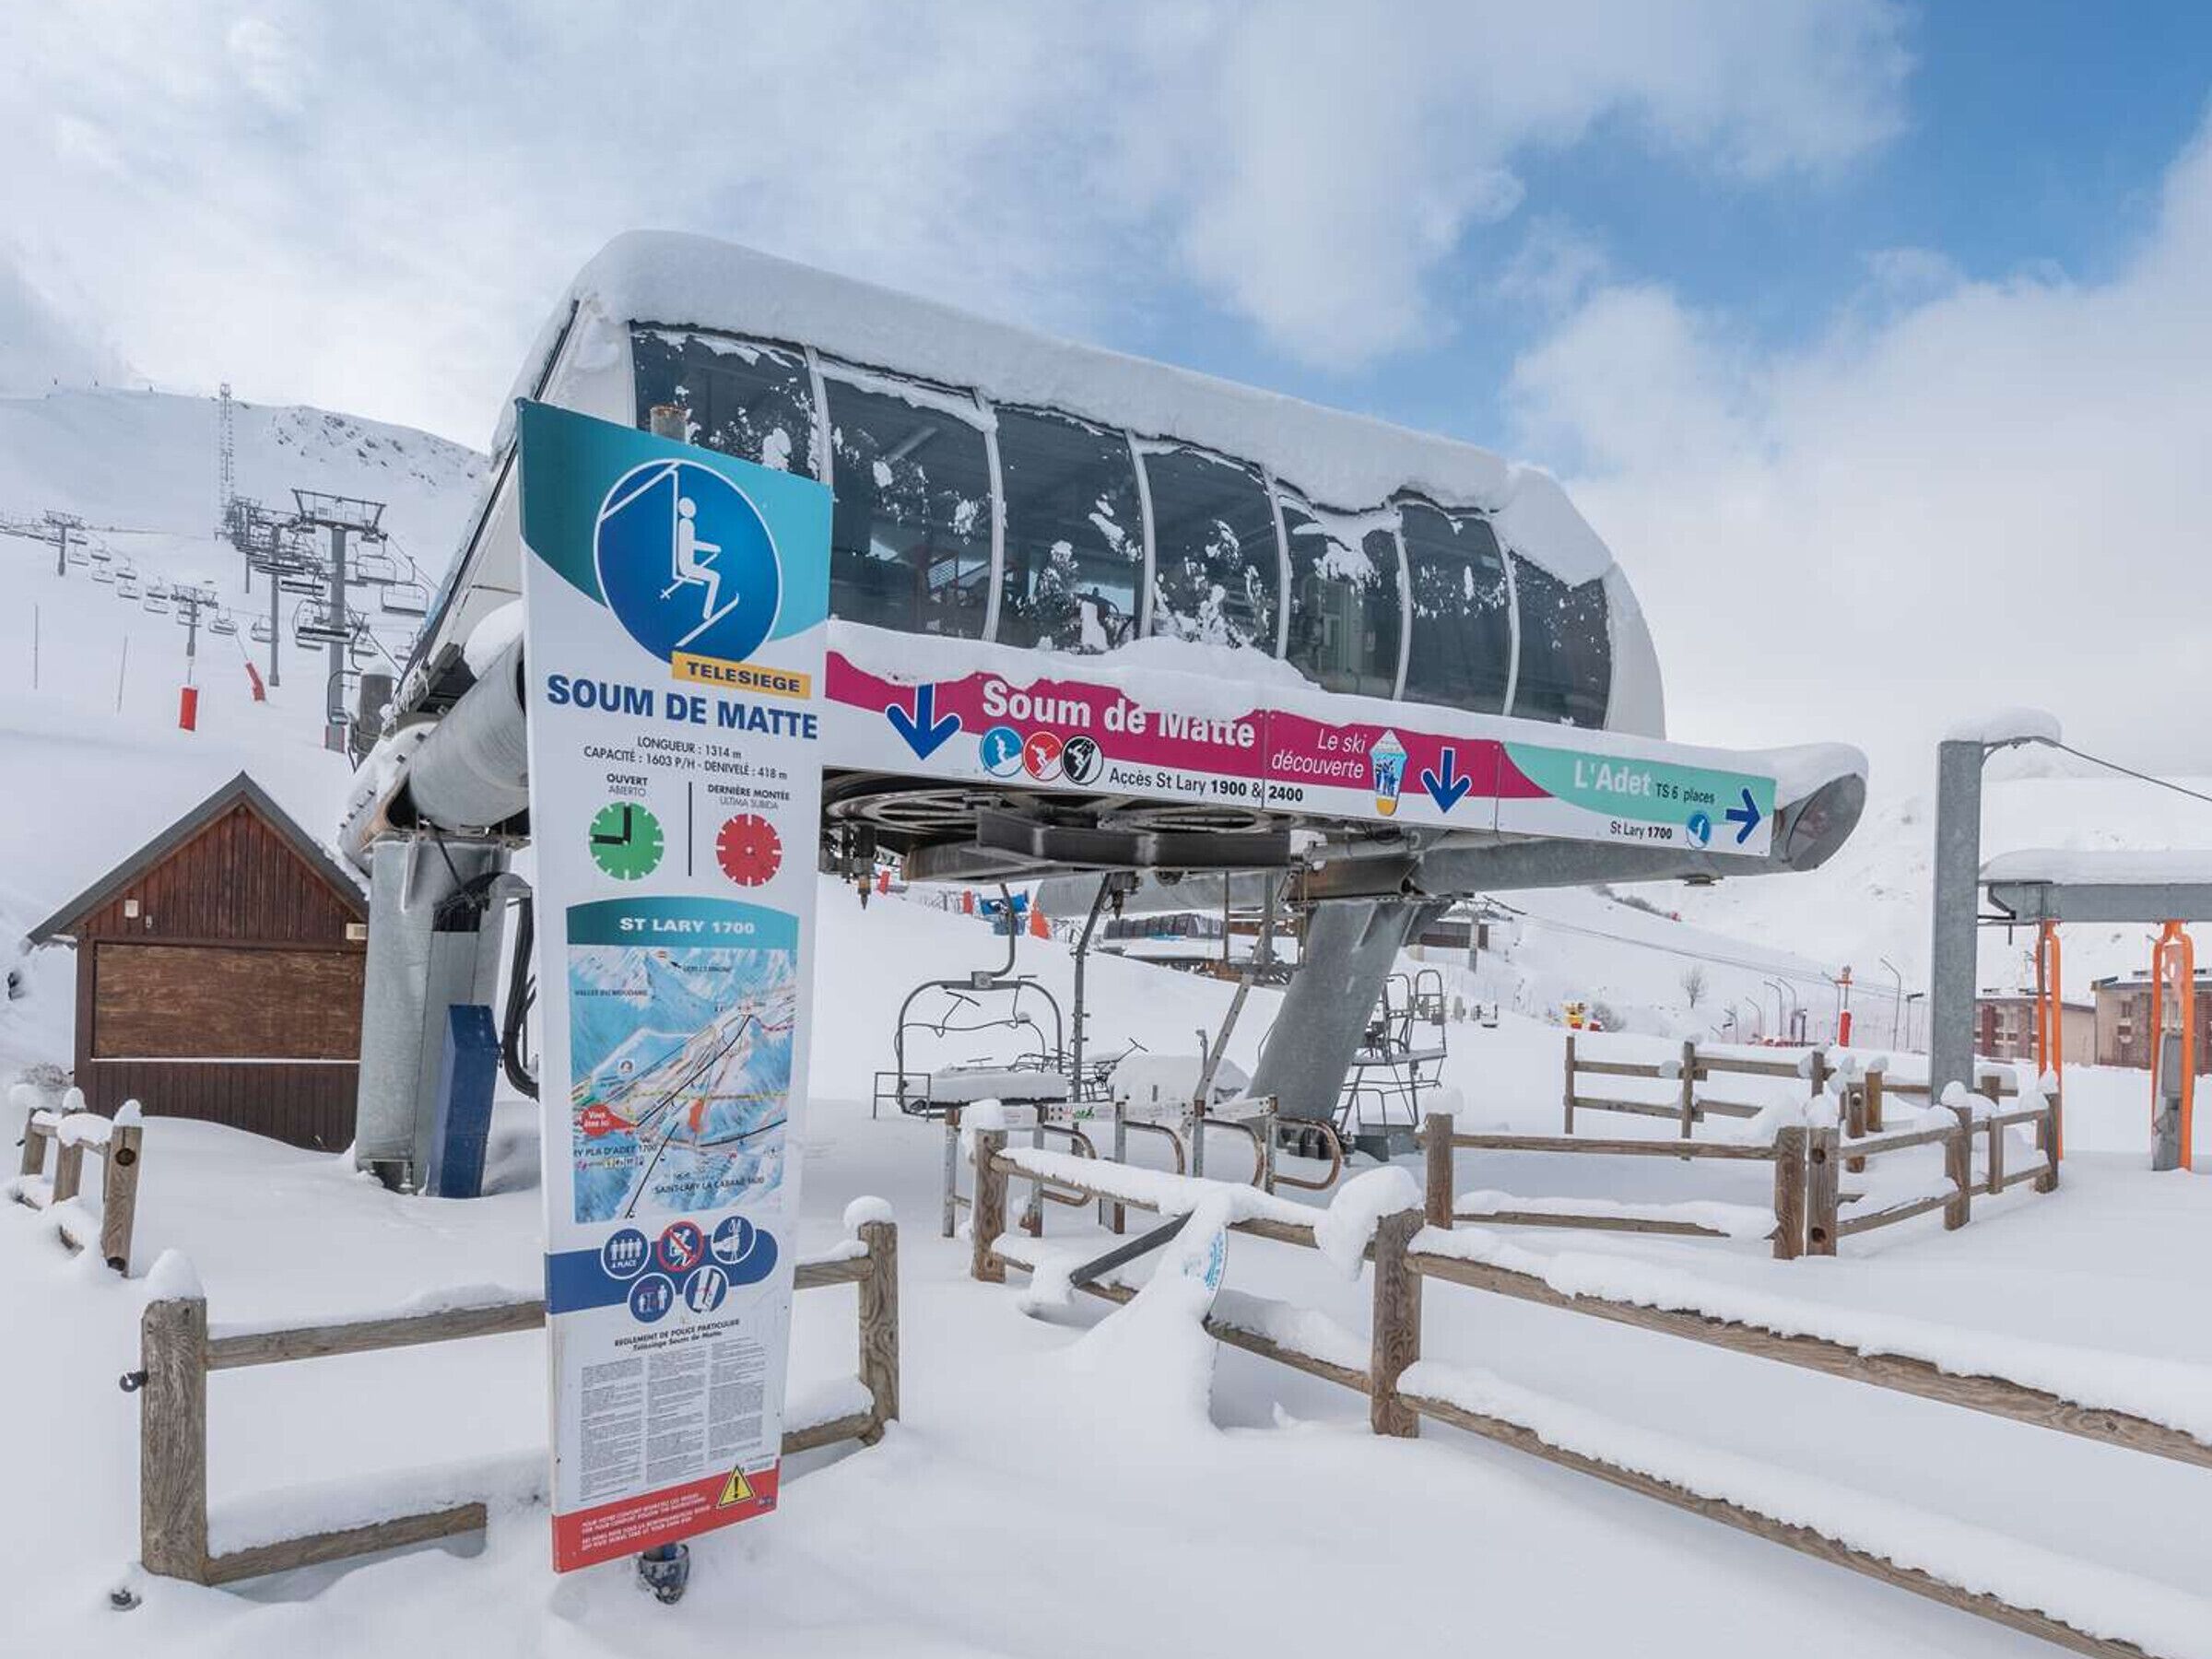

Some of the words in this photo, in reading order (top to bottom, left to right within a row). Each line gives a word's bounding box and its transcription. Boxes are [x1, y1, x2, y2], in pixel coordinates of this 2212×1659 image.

[687, 661, 801, 692] TELESIEGE
[547, 675, 654, 717] SOUM
[665, 693, 707, 725] DE
[718, 701, 818, 739] MATTE
[982, 680, 1091, 728] Soum
[1104, 698, 1147, 734] de
[1159, 711, 1255, 748] Matte
[637, 735, 696, 753] LONGUEUR
[706, 745, 730, 757] 1314
[1318, 728, 1338, 750] Le
[1342, 733, 1368, 753] ski
[583, 745, 636, 763] CAPACITÉ
[647, 752, 673, 767] 1603
[675, 756, 696, 770] P/H
[758, 766, 777, 780] 418
[779, 771, 788, 780] m
[1272, 749, 1364, 778] découverte
[606, 773, 648, 785] OUVERT
[1109, 767, 1152, 787] Accès
[1157, 772, 1172, 789] St
[1177, 774, 1206, 796] Lary
[1211, 780, 1247, 795] 1900
[1252, 782, 1263, 798] &
[1268, 785, 1304, 802] 2400
[1574, 759, 1652, 796] L'Adet
[1656, 783, 1670, 799] TS
[1672, 784, 1679, 800] 6
[1683, 789, 1715, 804] places
[1610, 820, 1622, 835] St
[1624, 822, 1645, 840] Lary
[1648, 827, 1673, 840] 1700
[619, 917, 647, 932] ST
[652, 918, 705, 934] LARY
[712, 921, 756, 935] 1700
